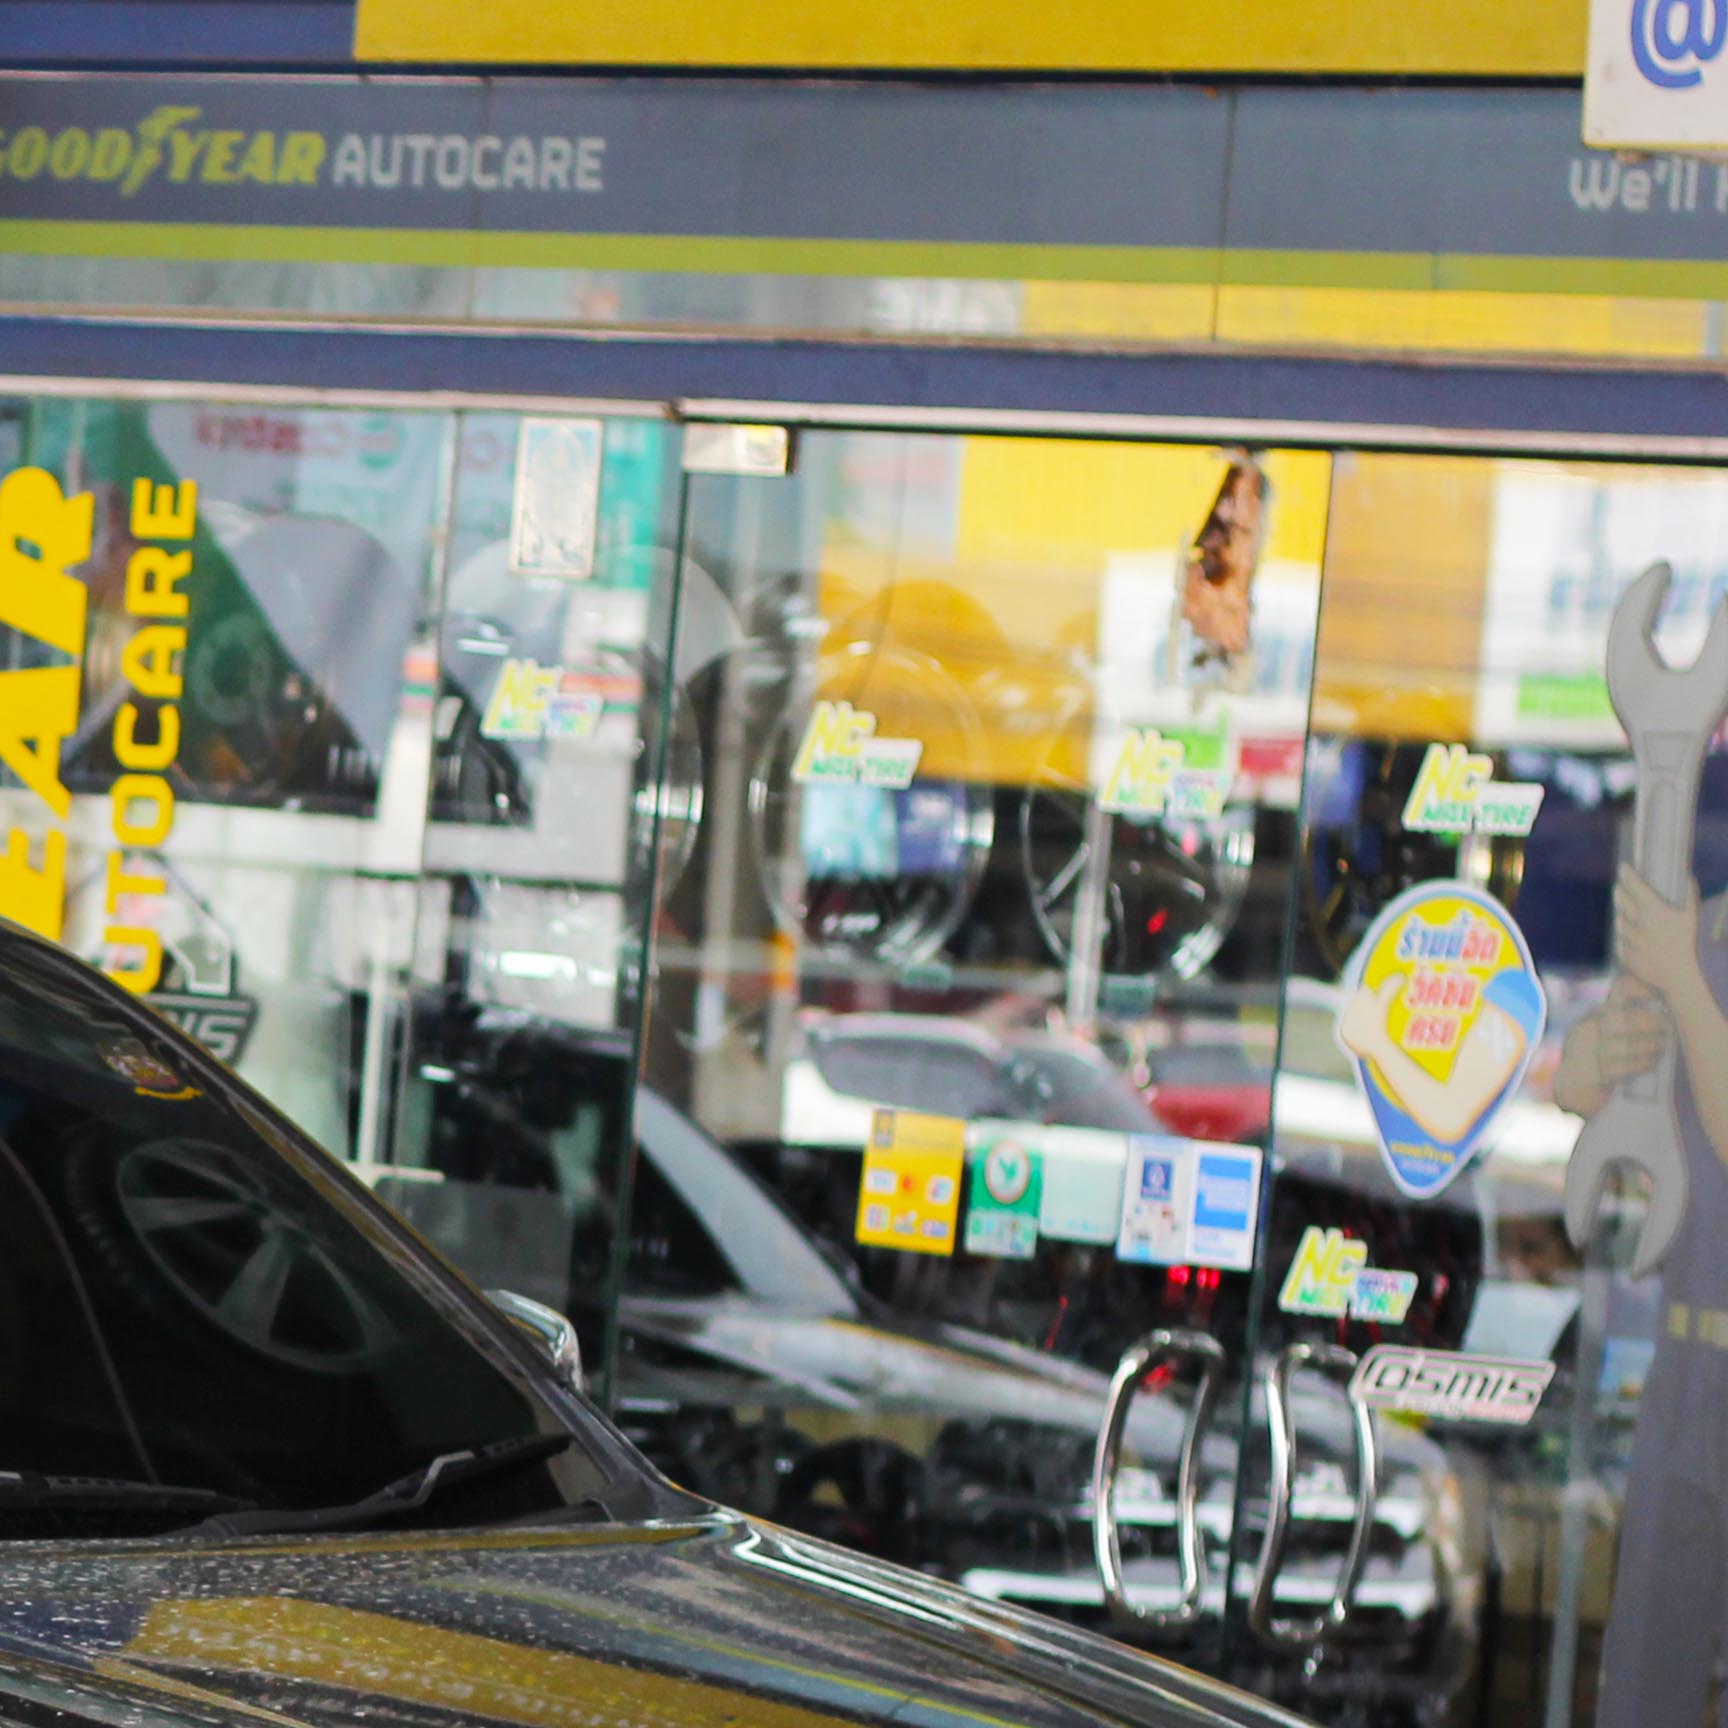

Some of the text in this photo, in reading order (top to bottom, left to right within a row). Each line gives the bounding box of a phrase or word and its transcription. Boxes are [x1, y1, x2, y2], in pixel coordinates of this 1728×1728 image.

[332, 133, 606, 191] AUTOCARE
[1569, 157, 1699, 211] We'll
[104, 477, 197, 995] UTOCARE
